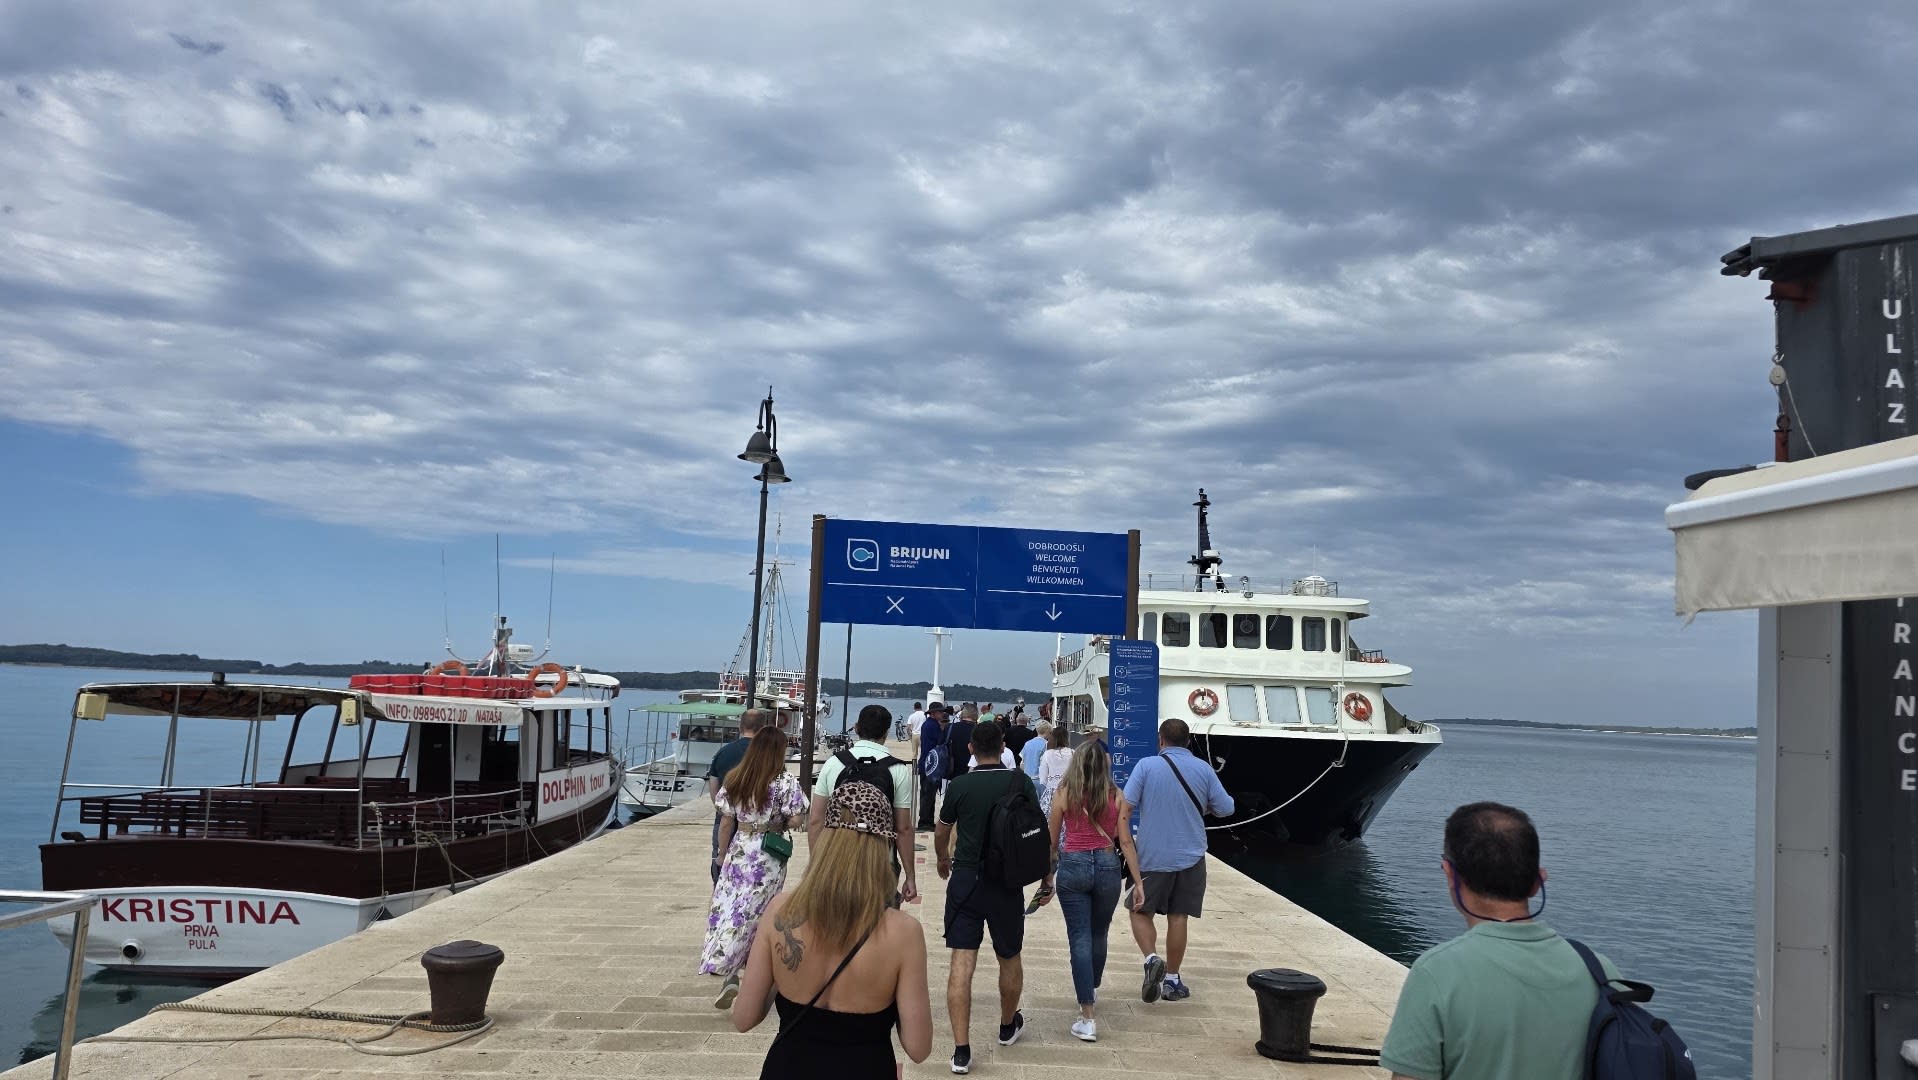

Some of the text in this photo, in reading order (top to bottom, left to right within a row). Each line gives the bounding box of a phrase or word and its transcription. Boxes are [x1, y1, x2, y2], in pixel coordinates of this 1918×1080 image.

[1882, 298, 1905, 423] ULAZ
[1028, 541, 1085, 552] DOBRODOŠLI
[890, 546, 950, 561] BRIJUNI
[1035, 553, 1077, 563] WELCOME
[1032, 564, 1079, 574] BENVENUTI
[1027, 575, 1084, 586] WILLKOMMEN
[385, 703, 411, 719] INFO:
[543, 774, 605, 804] DOLPHIN tour
[101, 898, 300, 925] KRISTINA
[184, 925, 219, 937] PRVA
[189, 939, 216, 950] PULA
